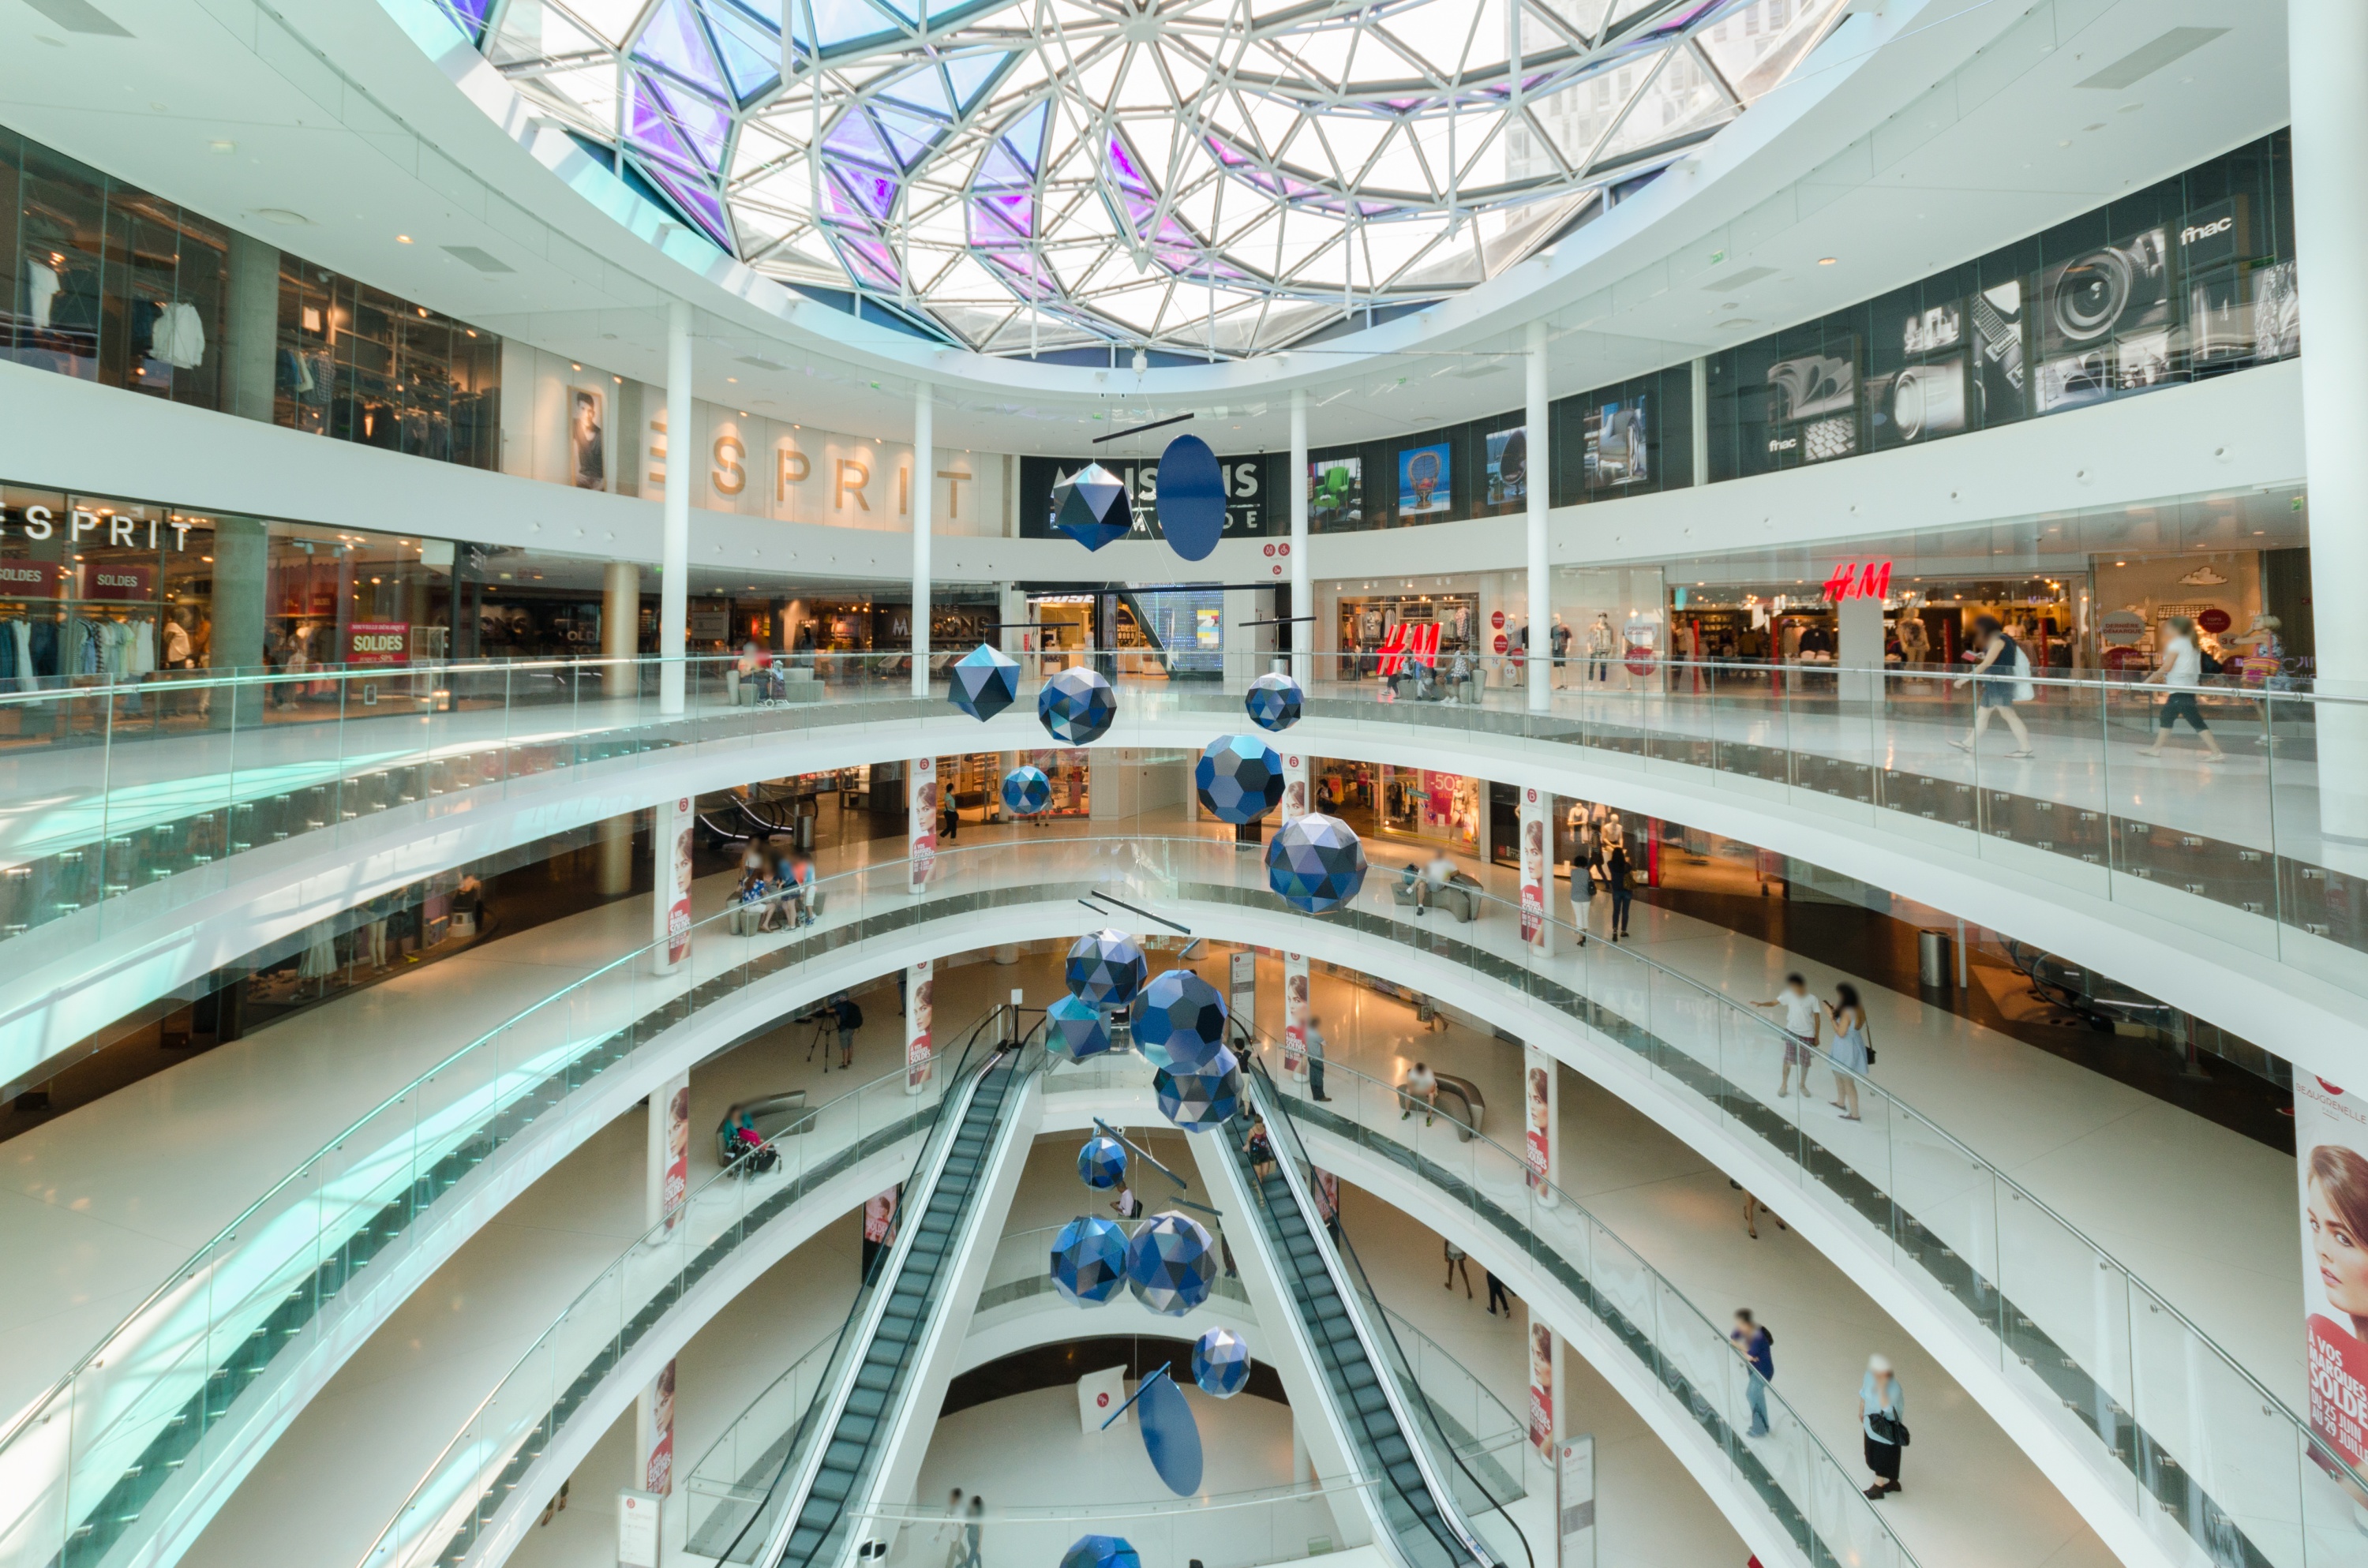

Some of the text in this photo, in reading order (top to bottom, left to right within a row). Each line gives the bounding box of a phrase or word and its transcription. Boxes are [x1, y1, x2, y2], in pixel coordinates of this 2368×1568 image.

[2180, 216, 2232, 247] fnac
[1768, 436, 1797, 452] fnac
[649, 421, 972, 518] ESPRIT
[0, 502, 192, 552] SPRIT
[97, 574, 138, 588] SOLDES
[1823, 560, 1894, 602] H&M
[354, 635, 403, 651] SOLDES
[893, 616, 990, 637] MSONS
[910, 1049, 931, 1064] SOLDES
[2295, 1082, 2367, 1125] BEAUGRENELLE
[2309, 1325, 2343, 1368] À VOS
[2311, 1387, 2362, 1443] DU 25 JUIN
[2312, 1404, 2323, 1426] AU
[2325, 1416, 2336, 1437] 29
